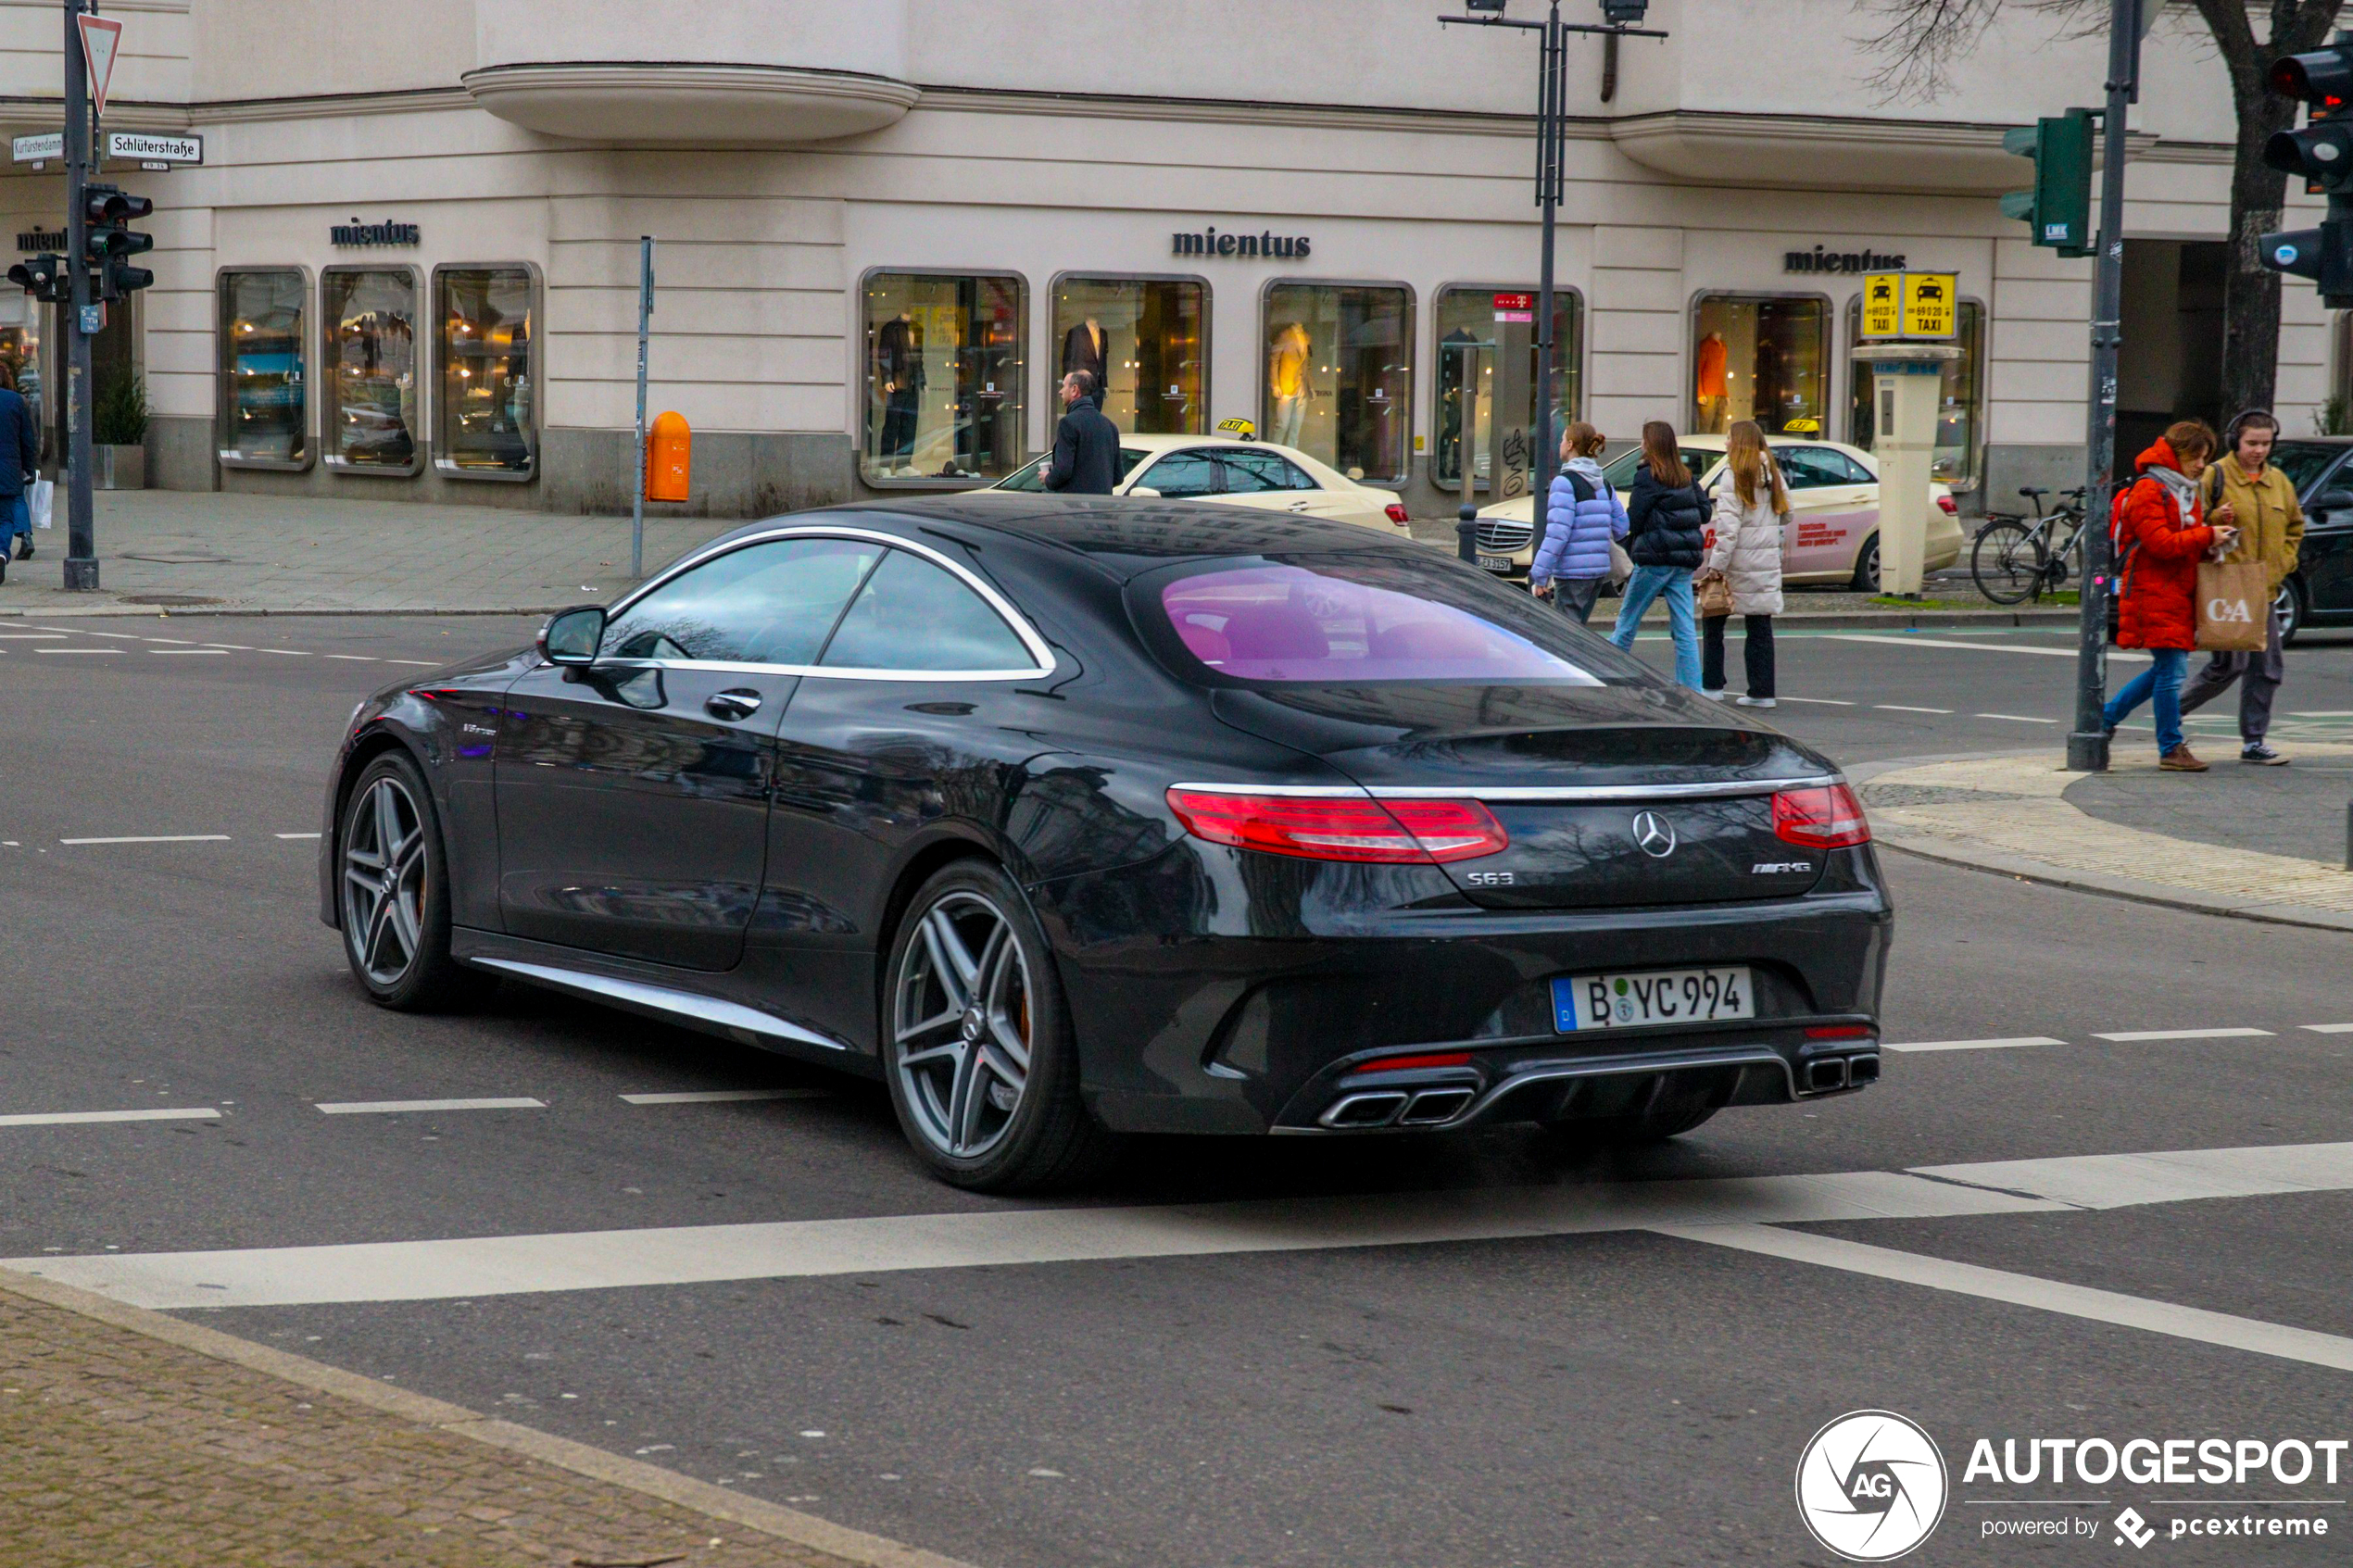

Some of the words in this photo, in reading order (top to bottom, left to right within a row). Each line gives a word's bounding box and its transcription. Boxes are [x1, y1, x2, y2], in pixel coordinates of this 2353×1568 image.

[14, 139, 62, 154] Kurfürstendamm
[115, 136, 195, 157] Schlüterstraße
[17, 226, 68, 251] mien
[330, 217, 420, 245] mientus
[1172, 226, 1311, 257] mientus
[1785, 245, 1906, 271] mientus
[1872, 319, 1889, 331] TAXI
[1917, 319, 1942, 332] TAXI
[1218, 420, 1242, 431] TAXI
[1491, 558, 1510, 570] 3157
[2207, 598, 2252, 622] C&A
[1467, 872, 1514, 885] S63
[1588, 982, 1611, 1022] B
[1632, 977, 1678, 1019] YC
[1683, 972, 1741, 1017] 994
